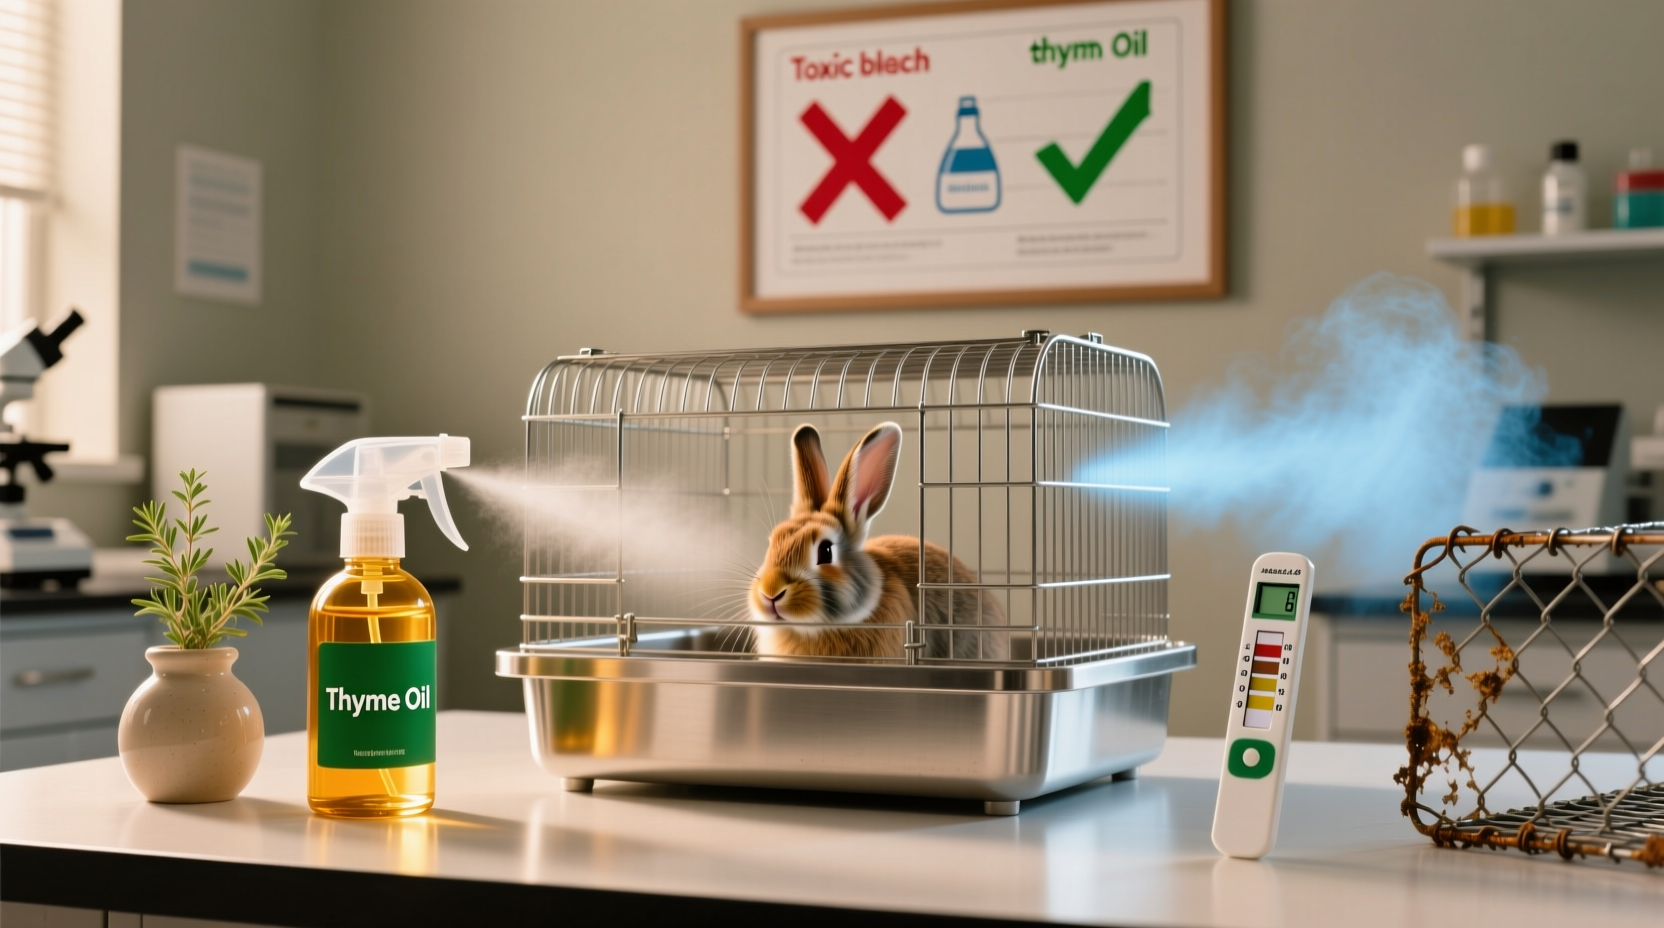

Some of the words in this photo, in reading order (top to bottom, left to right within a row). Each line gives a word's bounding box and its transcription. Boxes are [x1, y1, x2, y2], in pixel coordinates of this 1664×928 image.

[1111, 29, 1148, 58] Oil
[790, 51, 853, 81] Toxic
[859, 47, 930, 77] blech
[325, 686, 401, 718] Thyme
[404, 684, 431, 711] Oil
